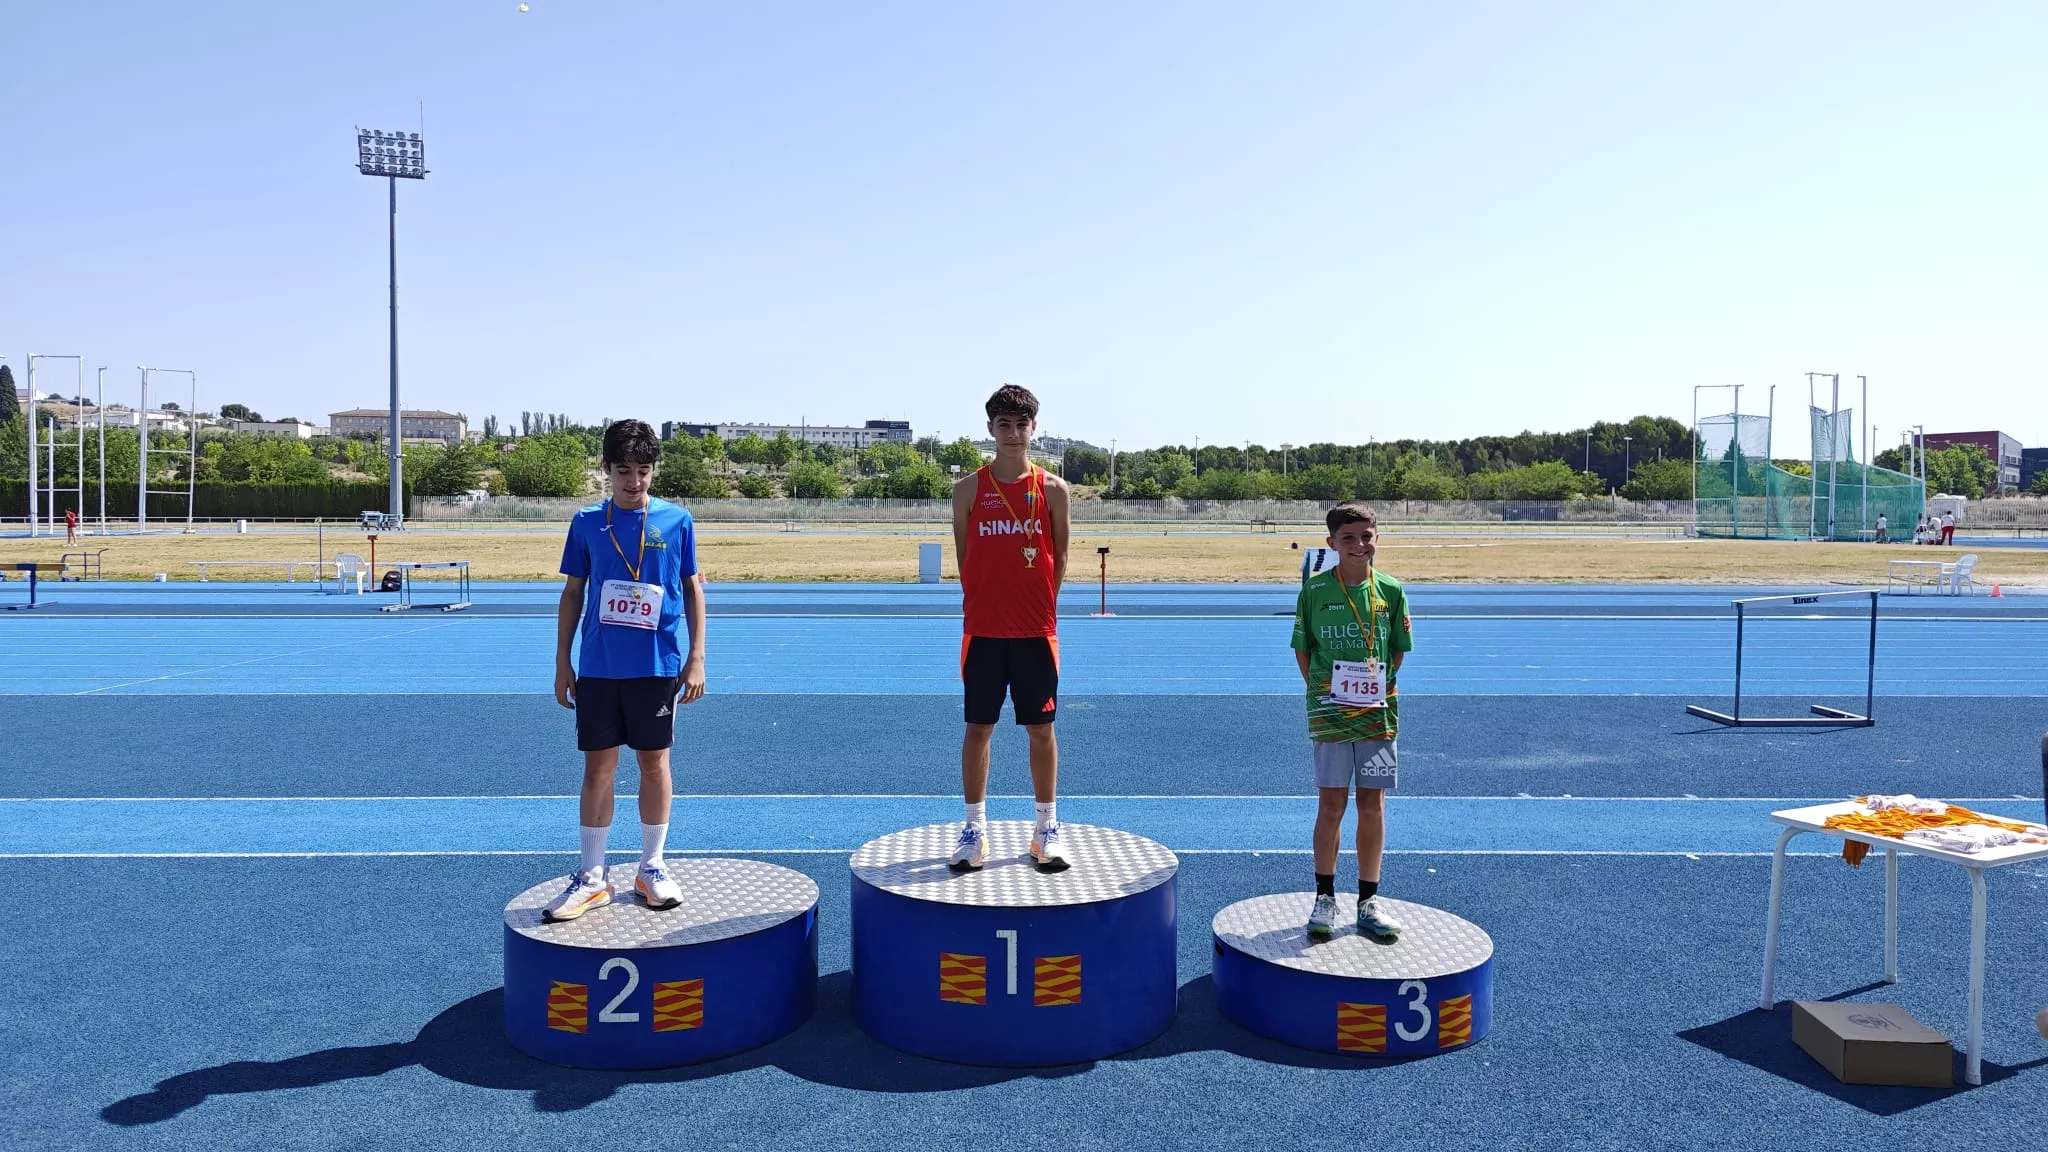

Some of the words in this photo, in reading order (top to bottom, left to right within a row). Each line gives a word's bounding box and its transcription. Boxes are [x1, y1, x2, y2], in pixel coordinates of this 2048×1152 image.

[608, 599, 652, 616] 1079
[1320, 622, 1387, 639] Huesca
[1330, 640, 1343, 649] La
[1341, 680, 1379, 695] 1135
[996, 930, 1017, 994] 1
[598, 957, 639, 1023] 2
[1394, 980, 1432, 1042] 3
